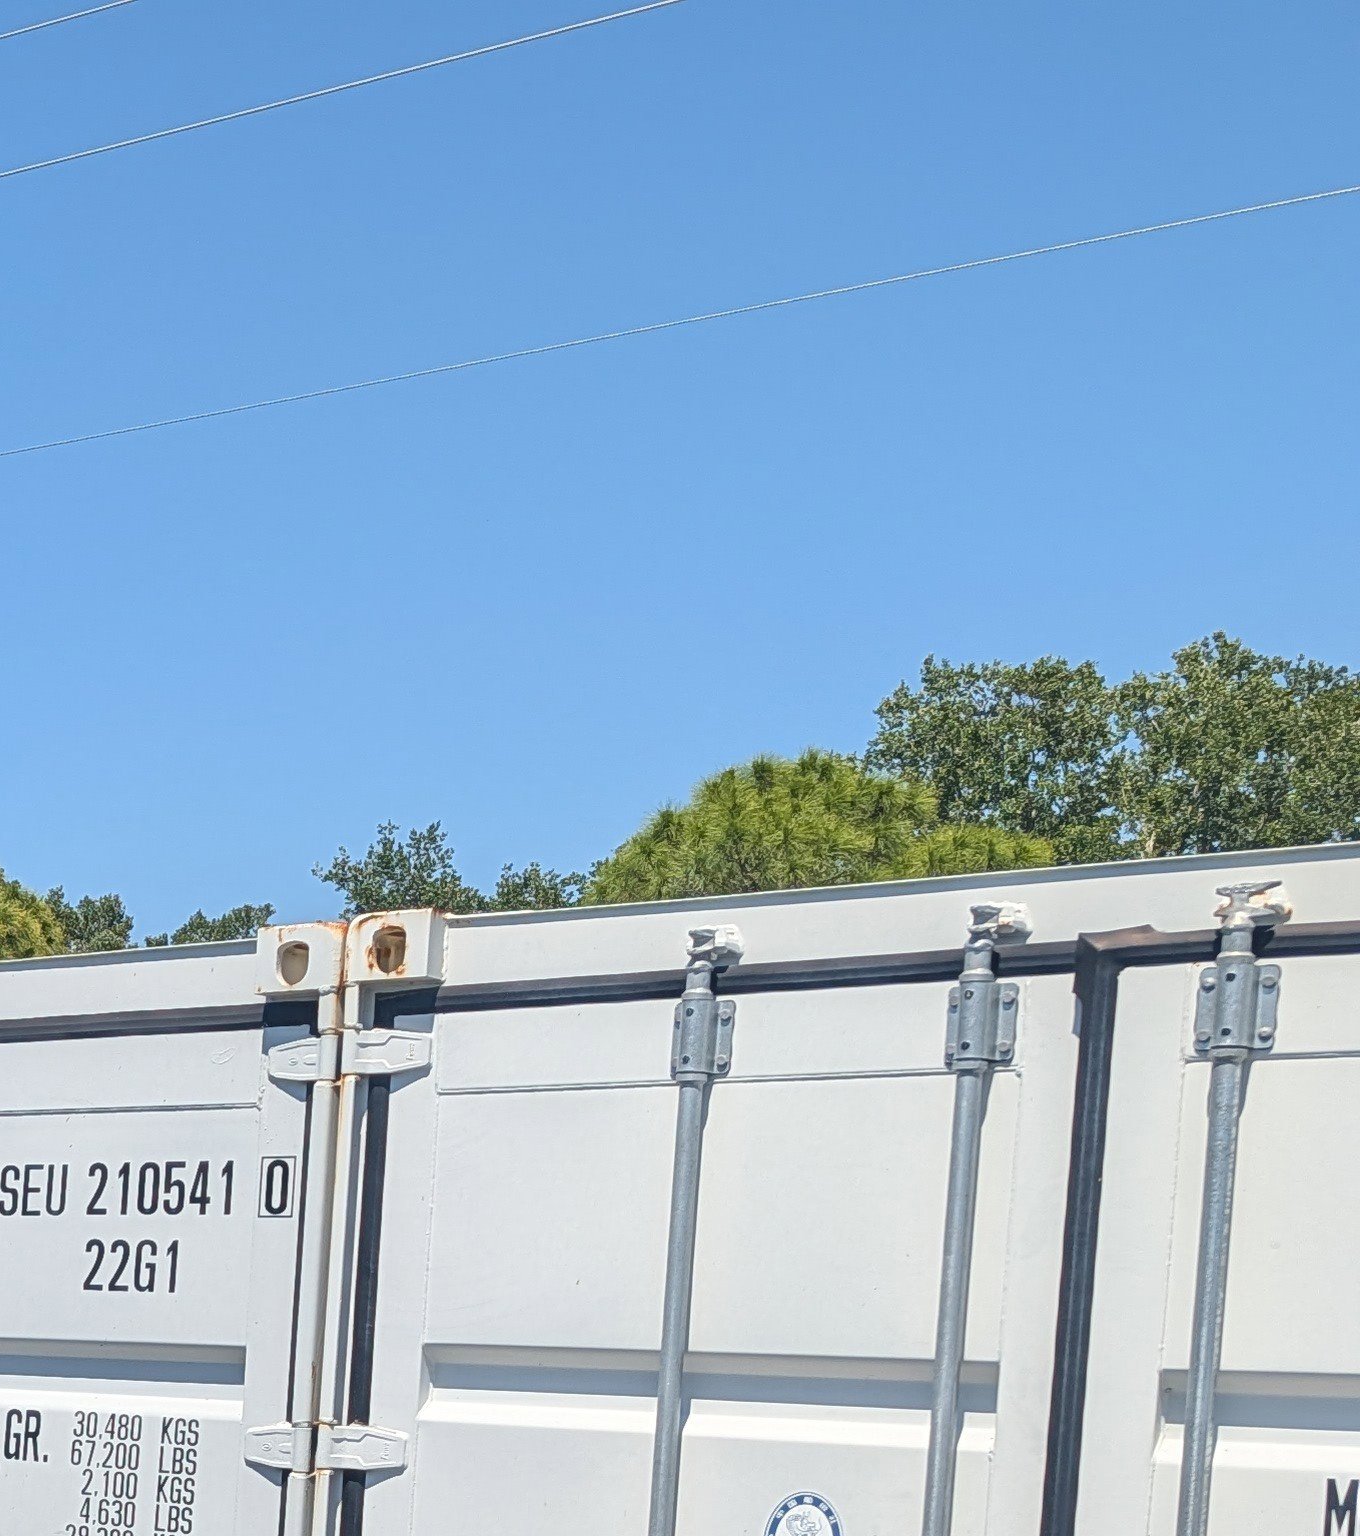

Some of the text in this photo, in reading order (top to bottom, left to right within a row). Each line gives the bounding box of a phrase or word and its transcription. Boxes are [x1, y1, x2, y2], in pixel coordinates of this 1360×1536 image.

[85, 1160, 234, 1216] 210541
[262, 1158, 291, 1216] 0
[83, 1238, 179, 1293] 22G1
[72, 1410, 200, 1446] 30,480 KGS
[70, 1439, 198, 1476] 67,200 LBS
[80, 1468, 196, 1506] 2,100 KGS
[79, 1497, 194, 1536] 4,630 LBS
